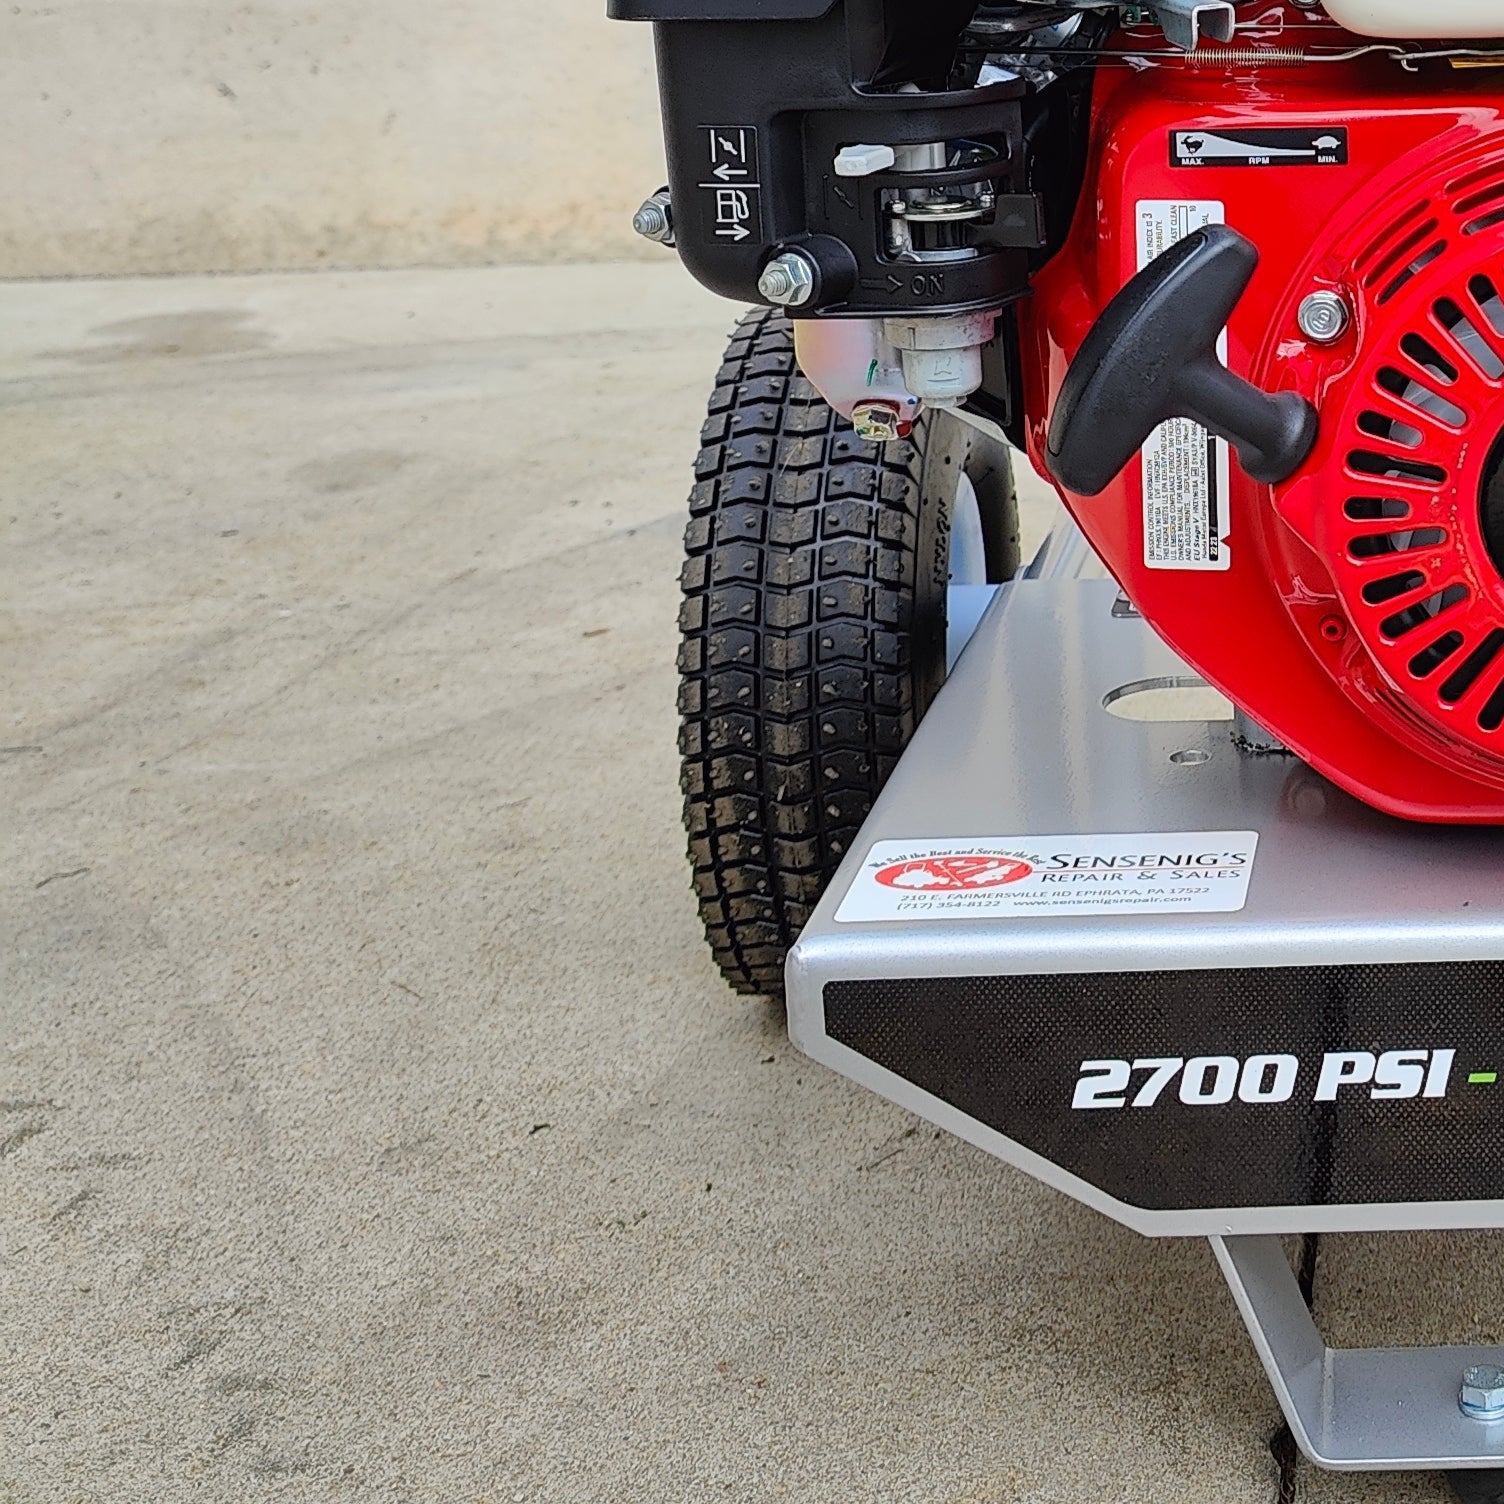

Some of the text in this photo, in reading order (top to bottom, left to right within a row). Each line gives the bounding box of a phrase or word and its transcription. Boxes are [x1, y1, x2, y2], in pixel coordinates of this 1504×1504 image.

[1181, 157, 1204, 166] MAX.
[1248, 157, 1270, 165] RPM
[1317, 155, 1338, 163] MIN.
[912, 273, 944, 296] ON
[1194, 549, 1200, 561] EU
[976, 848, 1012, 856] Service
[1046, 852, 1247, 870] SENSENIG'S
[1041, 869, 1240, 883] REPAIR & SALES
[947, 891, 1048, 900] FARMERSVILLE
[1051, 890, 1071, 898] RD
[897, 902, 932, 911] (717)
[1014, 896, 1192, 907] www.sensenigsrepair.com
[1072, 1054, 1299, 1109] 2700
[1313, 1048, 1456, 1102] PSI
